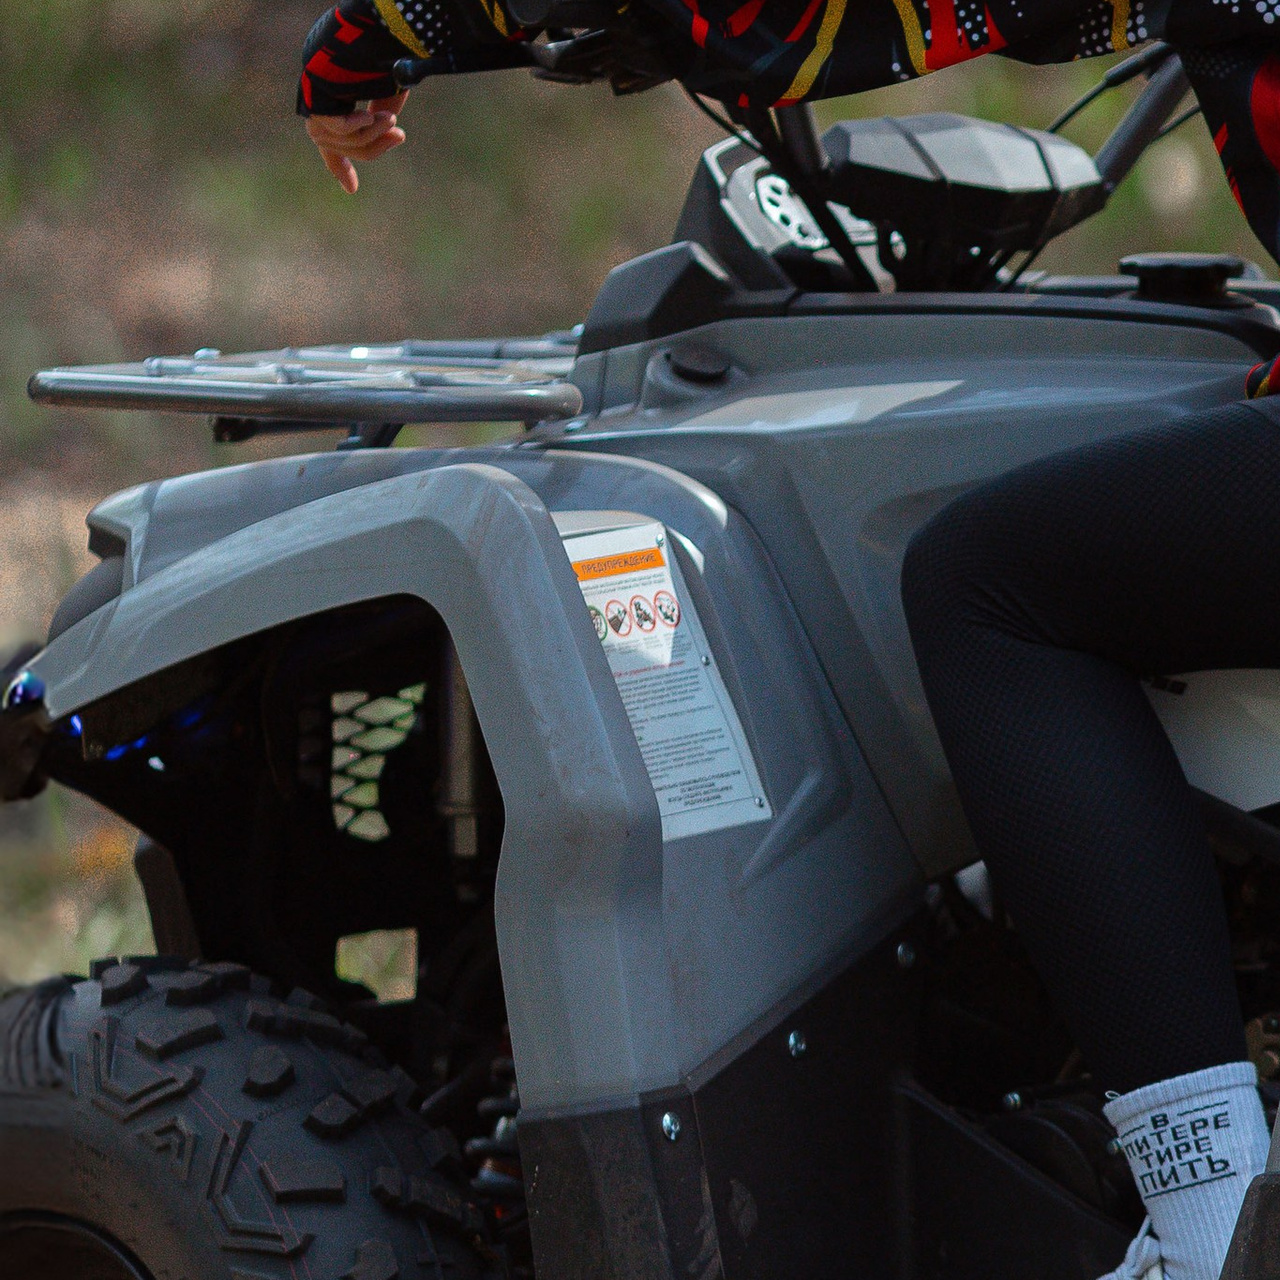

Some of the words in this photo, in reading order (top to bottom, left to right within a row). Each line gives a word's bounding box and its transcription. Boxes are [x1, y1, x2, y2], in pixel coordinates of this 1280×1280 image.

[581, 553, 656, 575] ПРЕДУПРЕЖДЕНИЕ
[1123, 1111, 1232, 1159] ПИТЕРЕ
[1151, 1113, 1170, 1130] В
[1139, 1136, 1213, 1170] ТИРЕ
[1138, 1154, 1231, 1194] ПИТЬ
